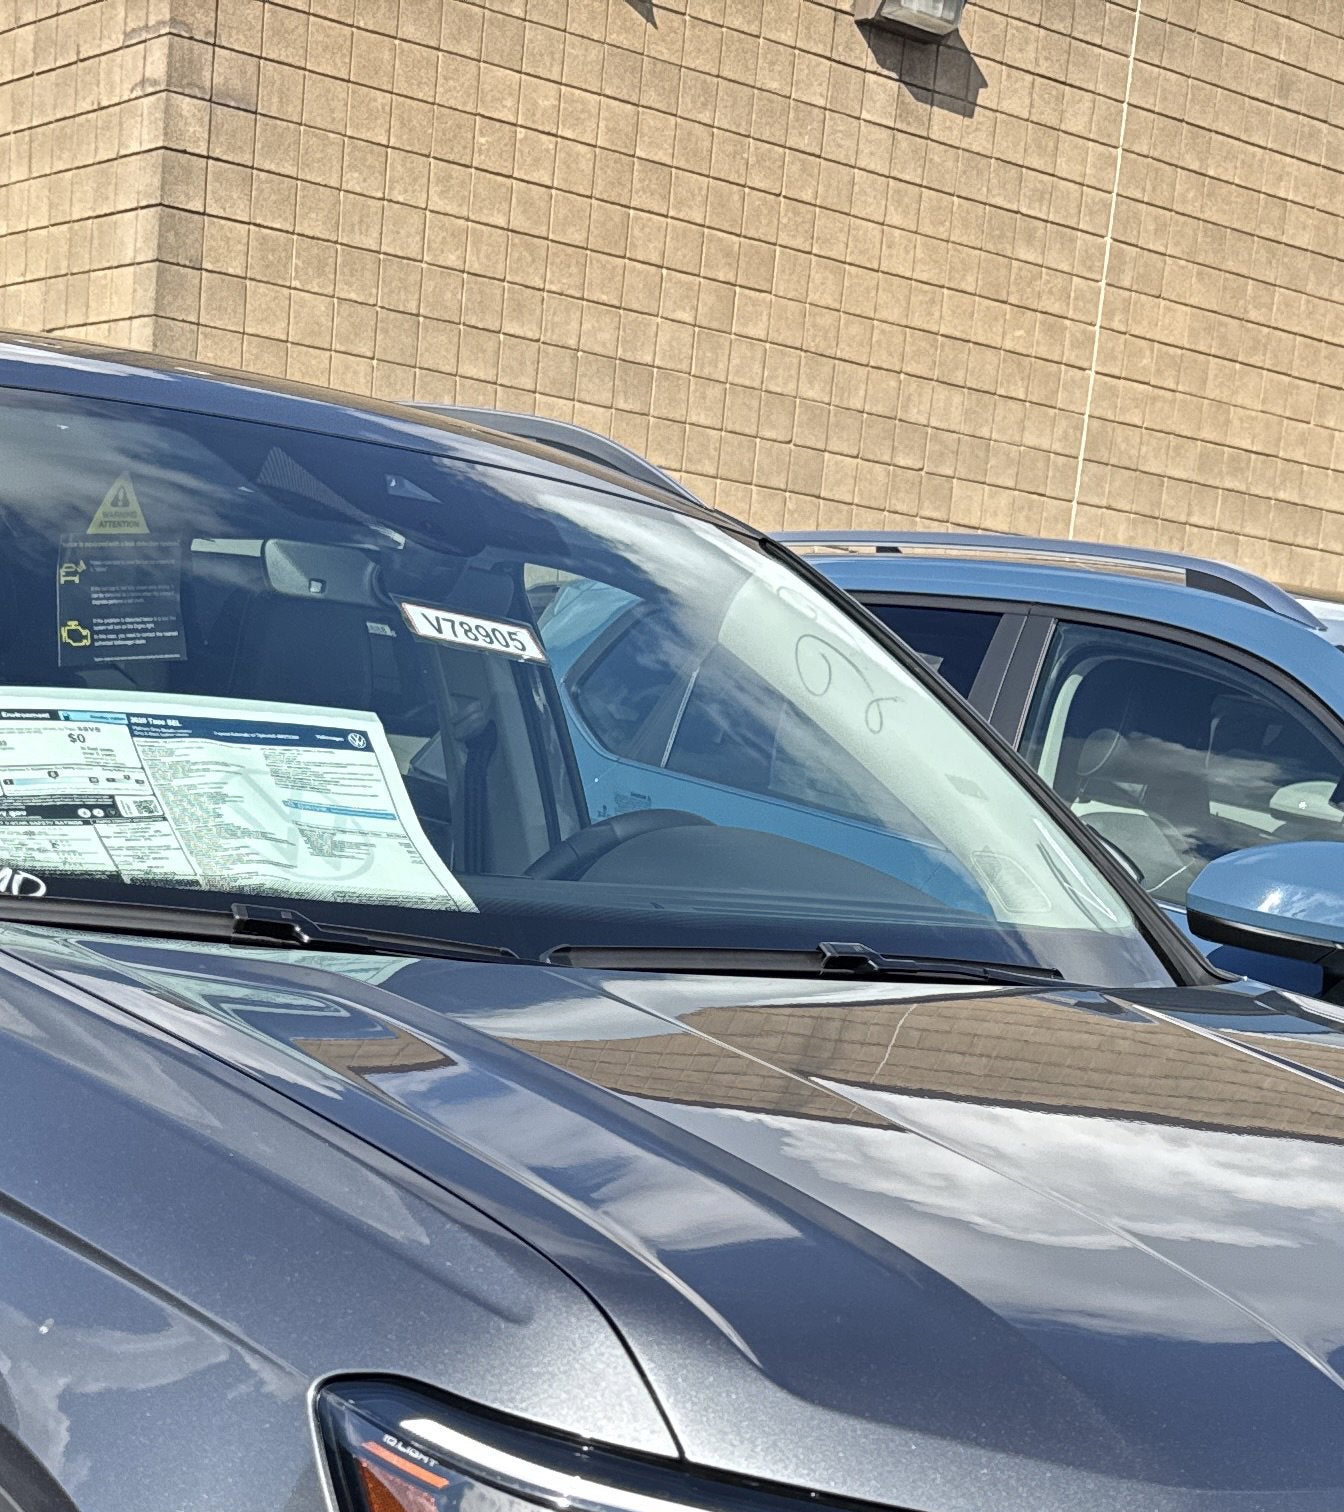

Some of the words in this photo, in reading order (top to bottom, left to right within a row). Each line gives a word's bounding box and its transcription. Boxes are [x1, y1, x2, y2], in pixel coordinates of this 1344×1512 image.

[99, 520, 139, 528] ATTENTION
[421, 612, 527, 652] V78905
[68, 733, 86, 744] $0
